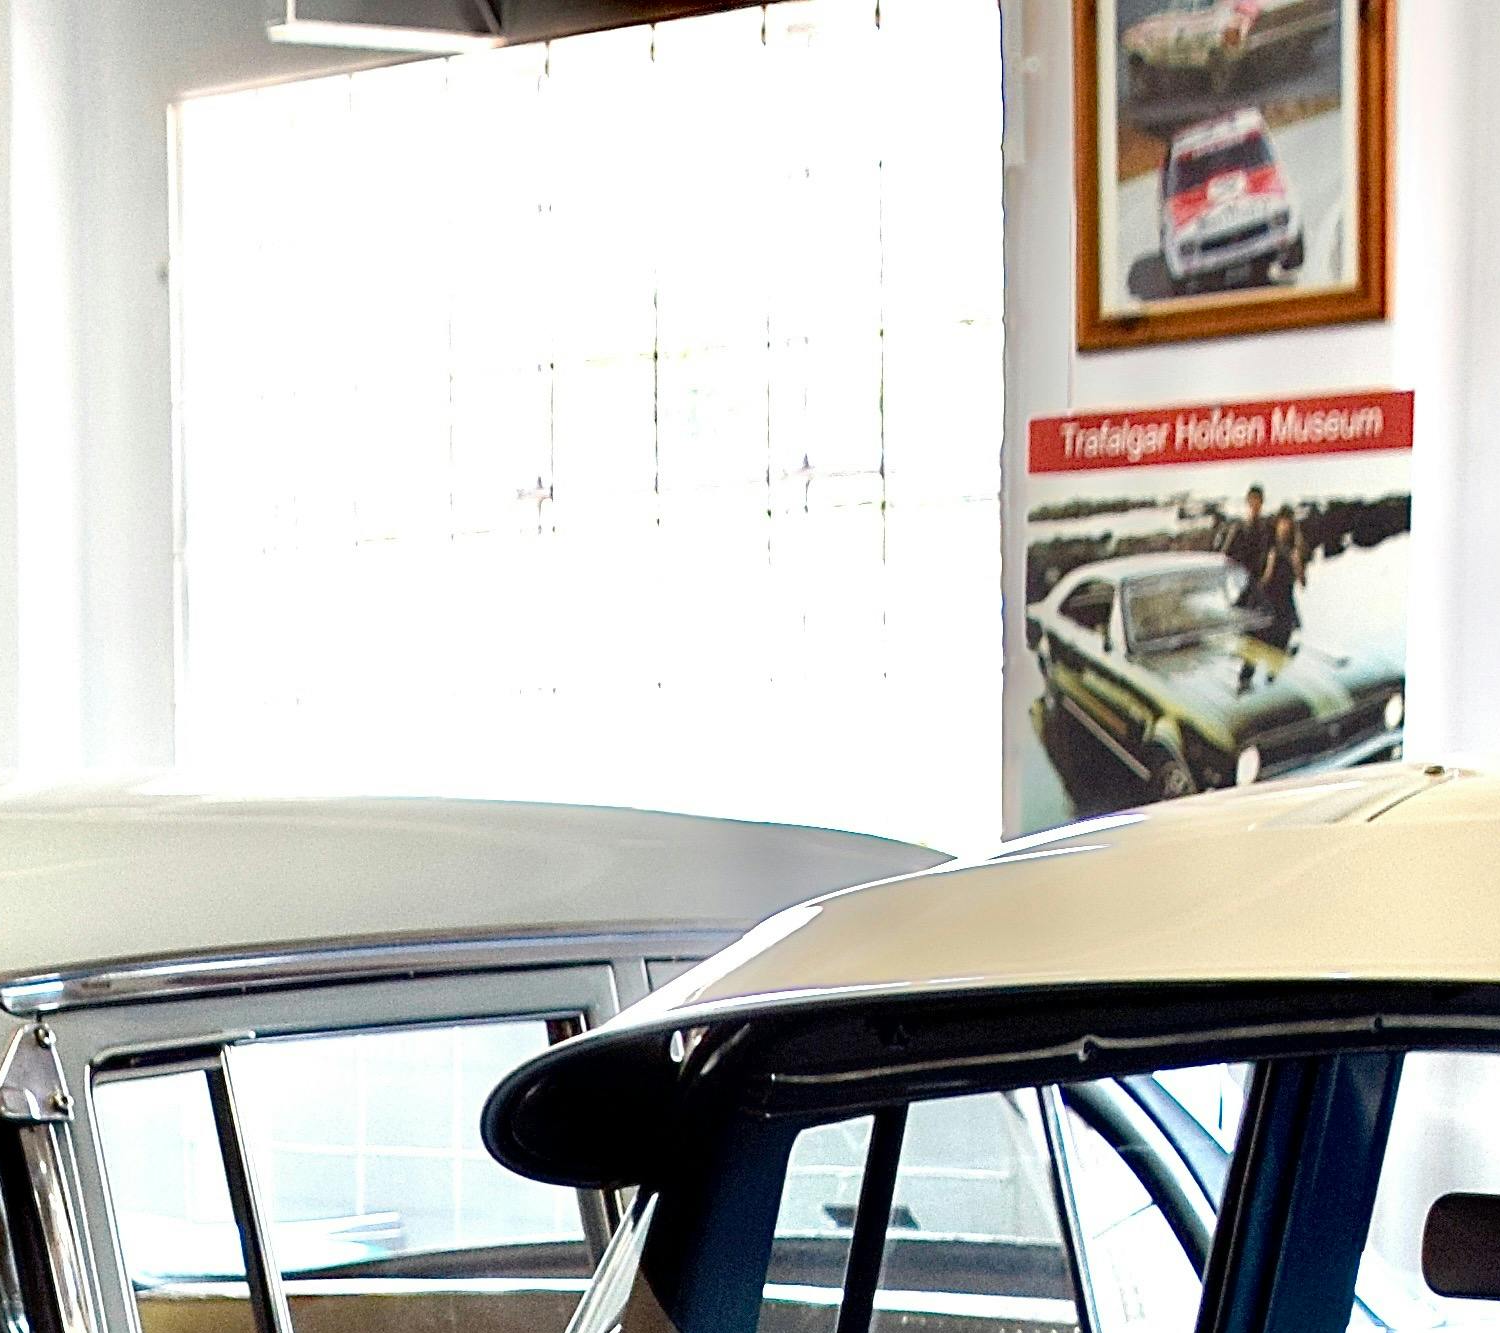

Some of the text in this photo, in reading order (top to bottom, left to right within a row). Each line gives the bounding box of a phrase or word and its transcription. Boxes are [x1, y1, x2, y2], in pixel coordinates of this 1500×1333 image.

[1060, 402, 1383, 463] Trafalgar Holden Museum
